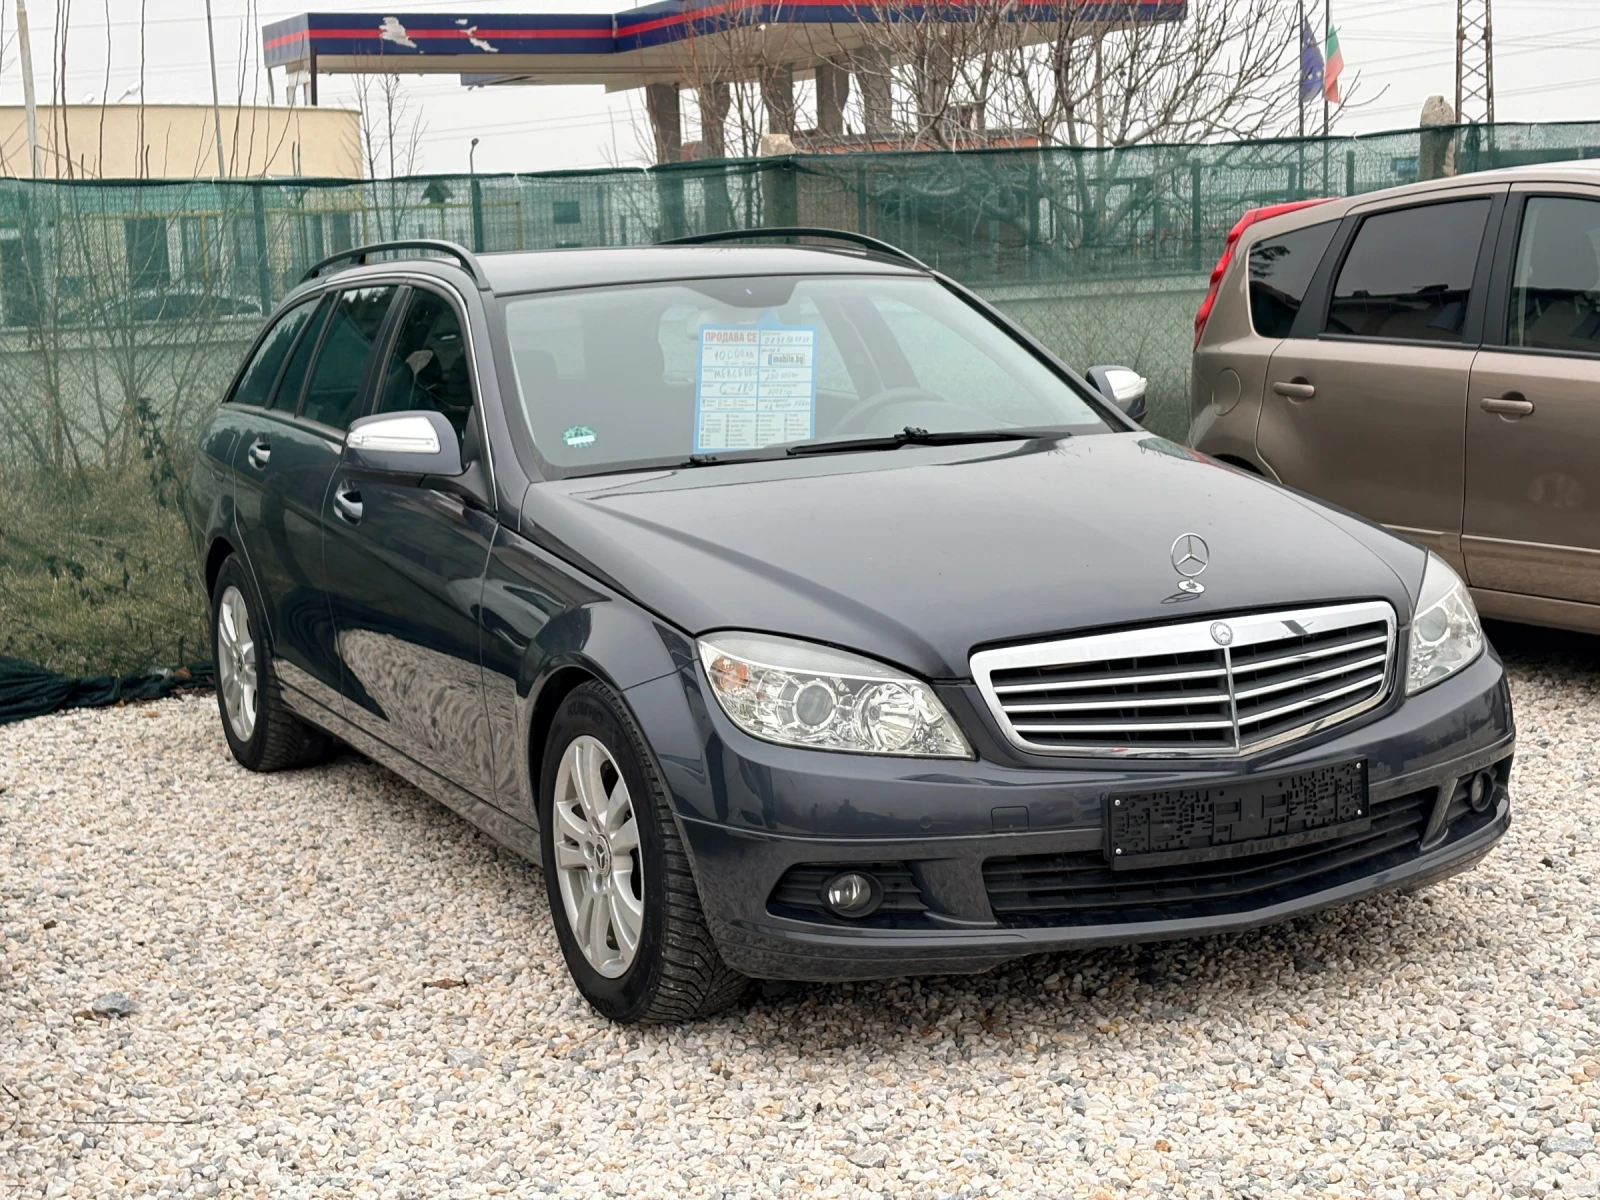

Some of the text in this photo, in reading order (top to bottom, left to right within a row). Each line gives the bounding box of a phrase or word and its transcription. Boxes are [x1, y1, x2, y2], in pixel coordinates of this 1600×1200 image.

[705, 332, 745, 343] ПРОДАВА
[747, 332, 757, 343] СЕ
[773, 354, 804, 365] mobile.bg
